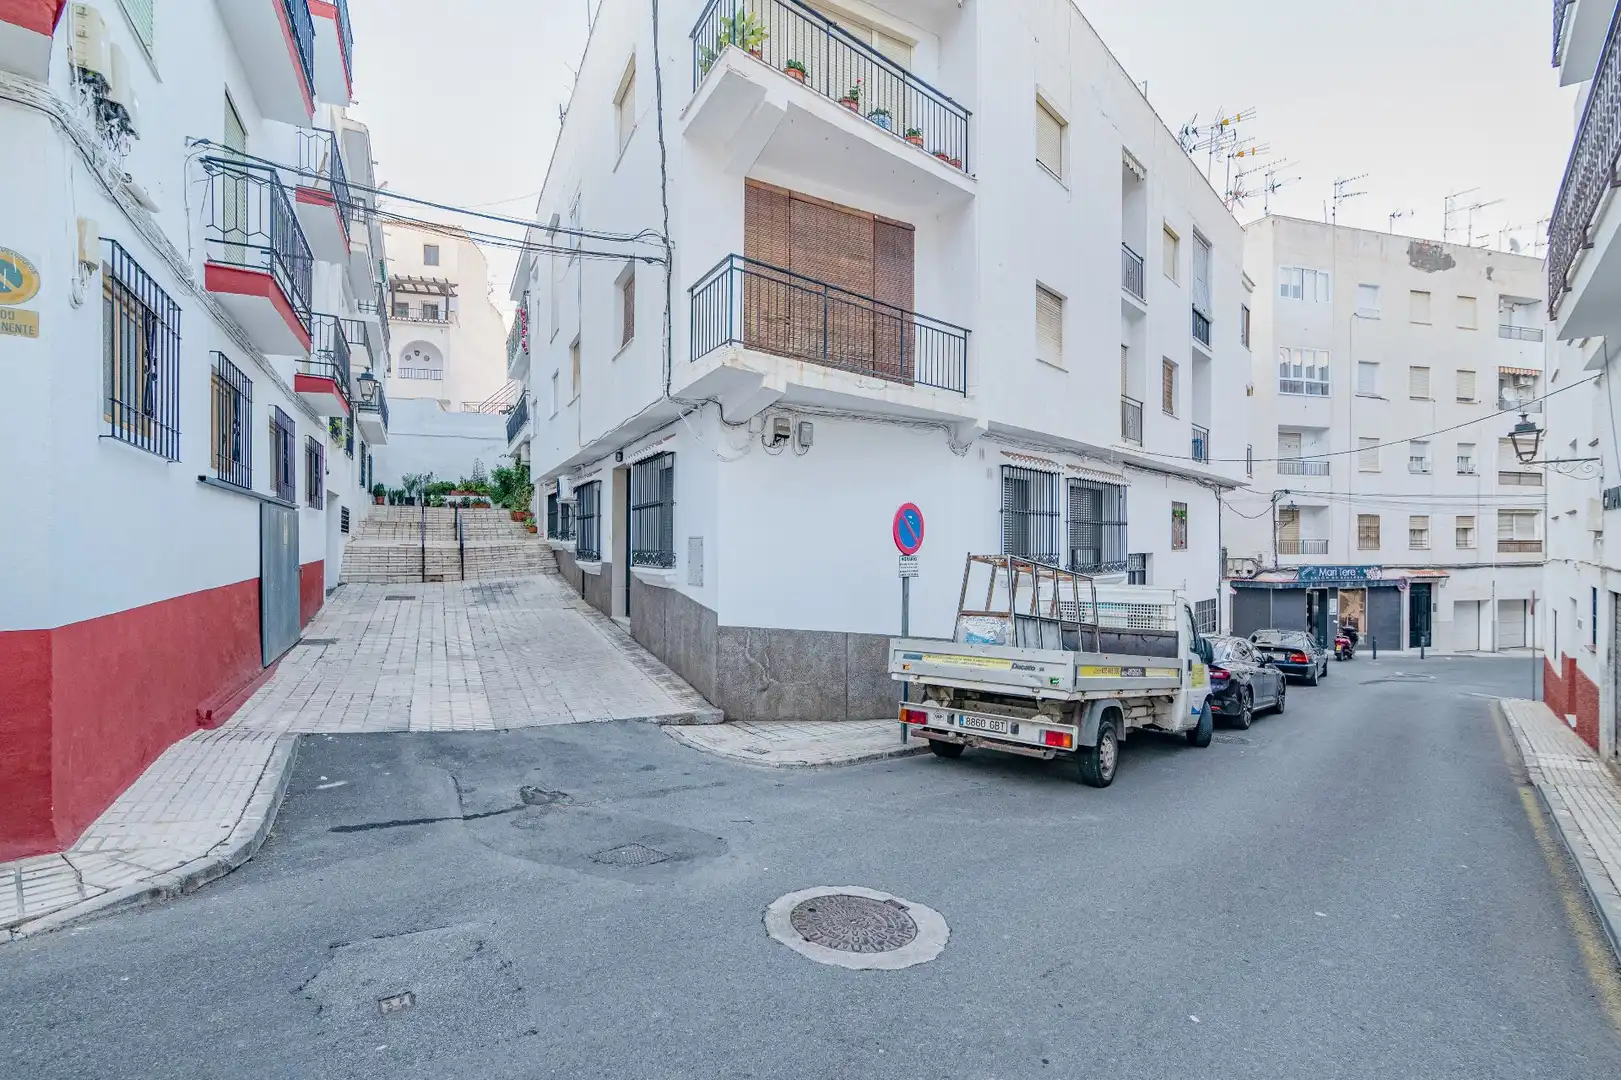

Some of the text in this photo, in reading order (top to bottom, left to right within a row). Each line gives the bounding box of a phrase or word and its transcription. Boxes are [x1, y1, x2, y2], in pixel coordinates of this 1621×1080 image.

[1318, 567, 1337, 577] Mari
[1338, 567, 1356, 576] Tere
[1011, 662, 1036, 672] Ducato
[965, 716, 1005, 731] 8860 GBT
